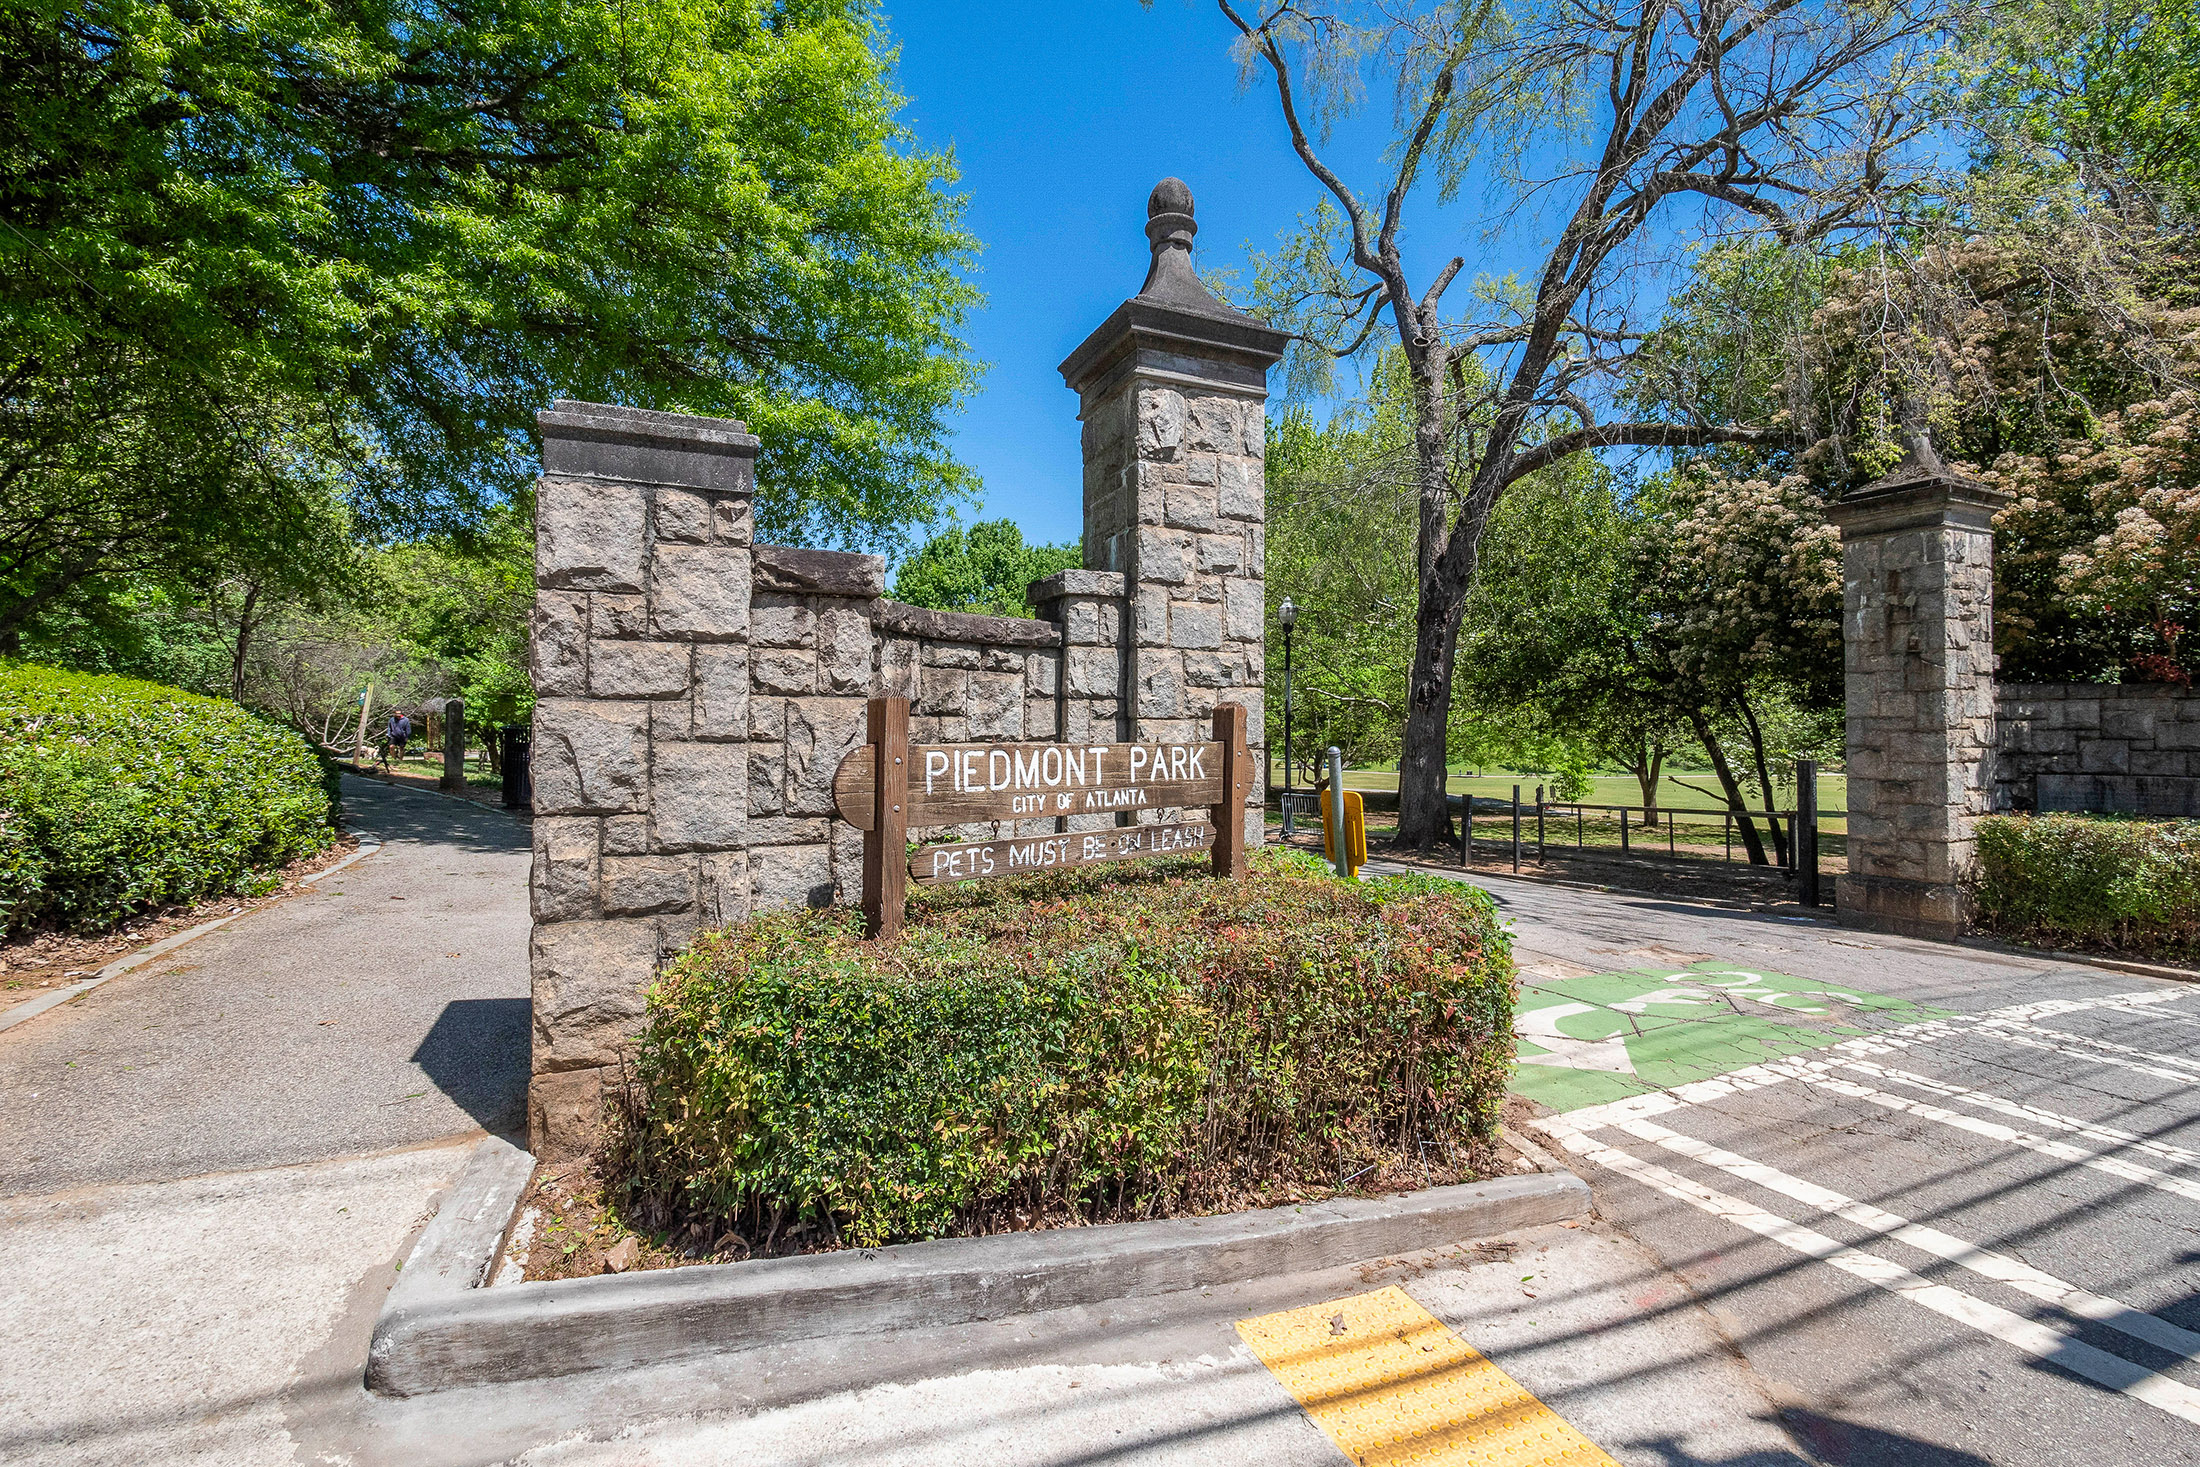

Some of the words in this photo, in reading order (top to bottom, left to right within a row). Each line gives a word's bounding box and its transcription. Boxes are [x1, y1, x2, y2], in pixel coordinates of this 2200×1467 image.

[926, 747, 1109, 796] PIEDMONT
[1130, 746, 1205, 784] PARK
[1012, 794, 1047, 814] CITY
[1057, 791, 1074, 810] OF
[1085, 788, 1147, 808] ATLANTA
[933, 846, 994, 879] PETS
[1009, 838, 1070, 867] MUST
[1083, 834, 1107, 860] BE
[1151, 825, 1204, 852] LEASH
